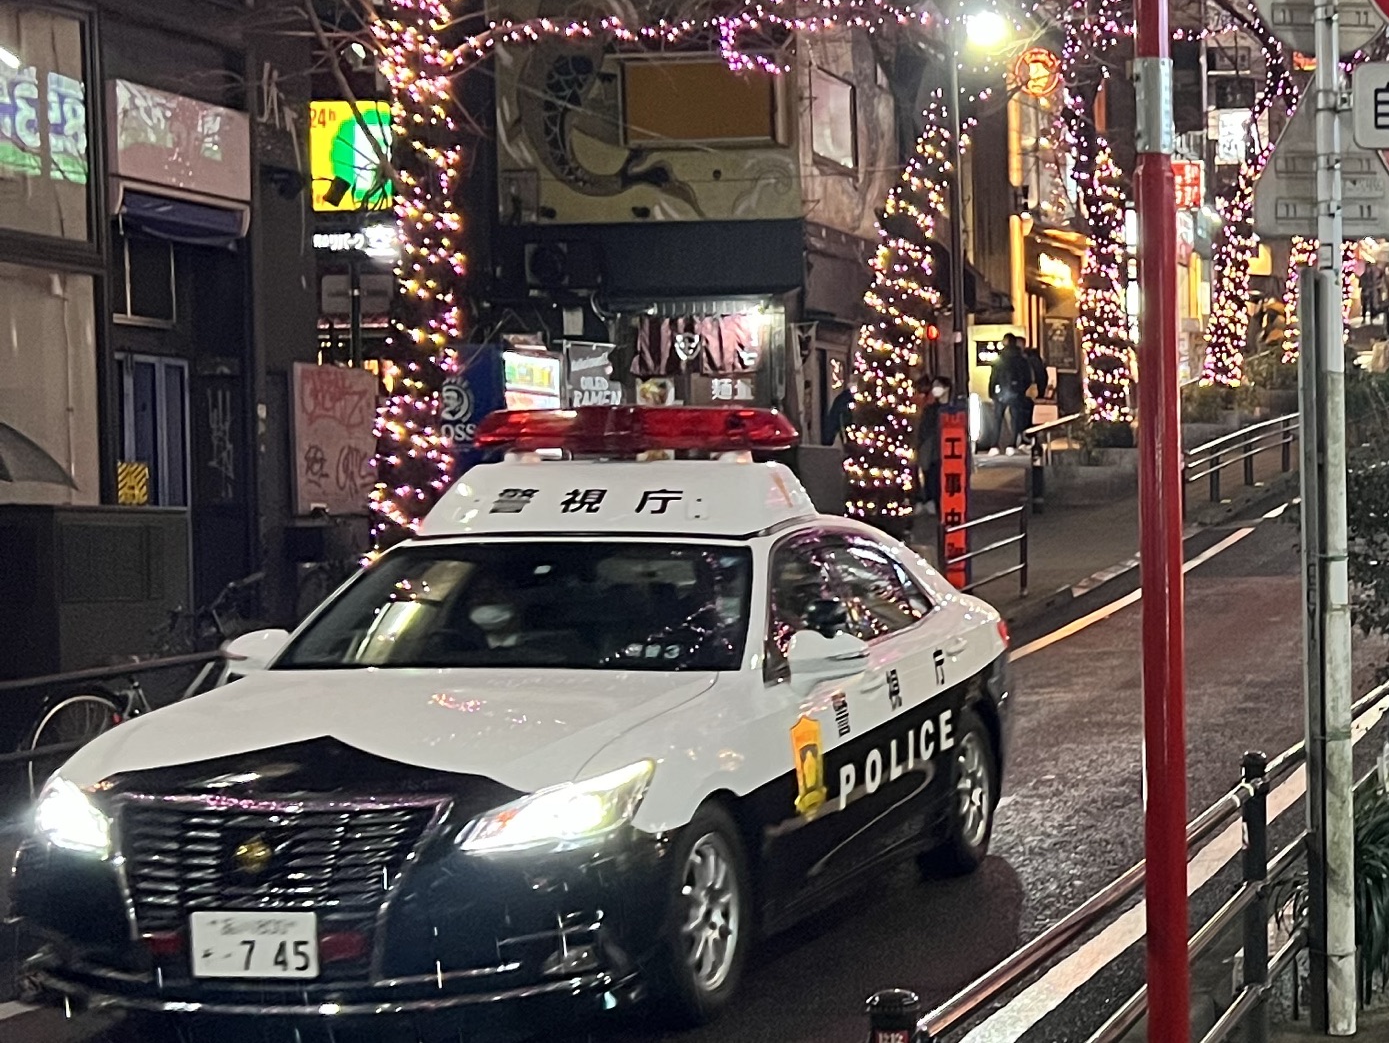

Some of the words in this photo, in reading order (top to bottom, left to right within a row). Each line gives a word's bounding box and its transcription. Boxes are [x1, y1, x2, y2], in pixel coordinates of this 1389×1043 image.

[573, 390, 622, 407] RAMEN
[438, 423, 477, 442] OSS
[944, 436, 963, 532] 工事中
[488, 487, 684, 515] 警視庁
[838, 709, 955, 811] POLICE
